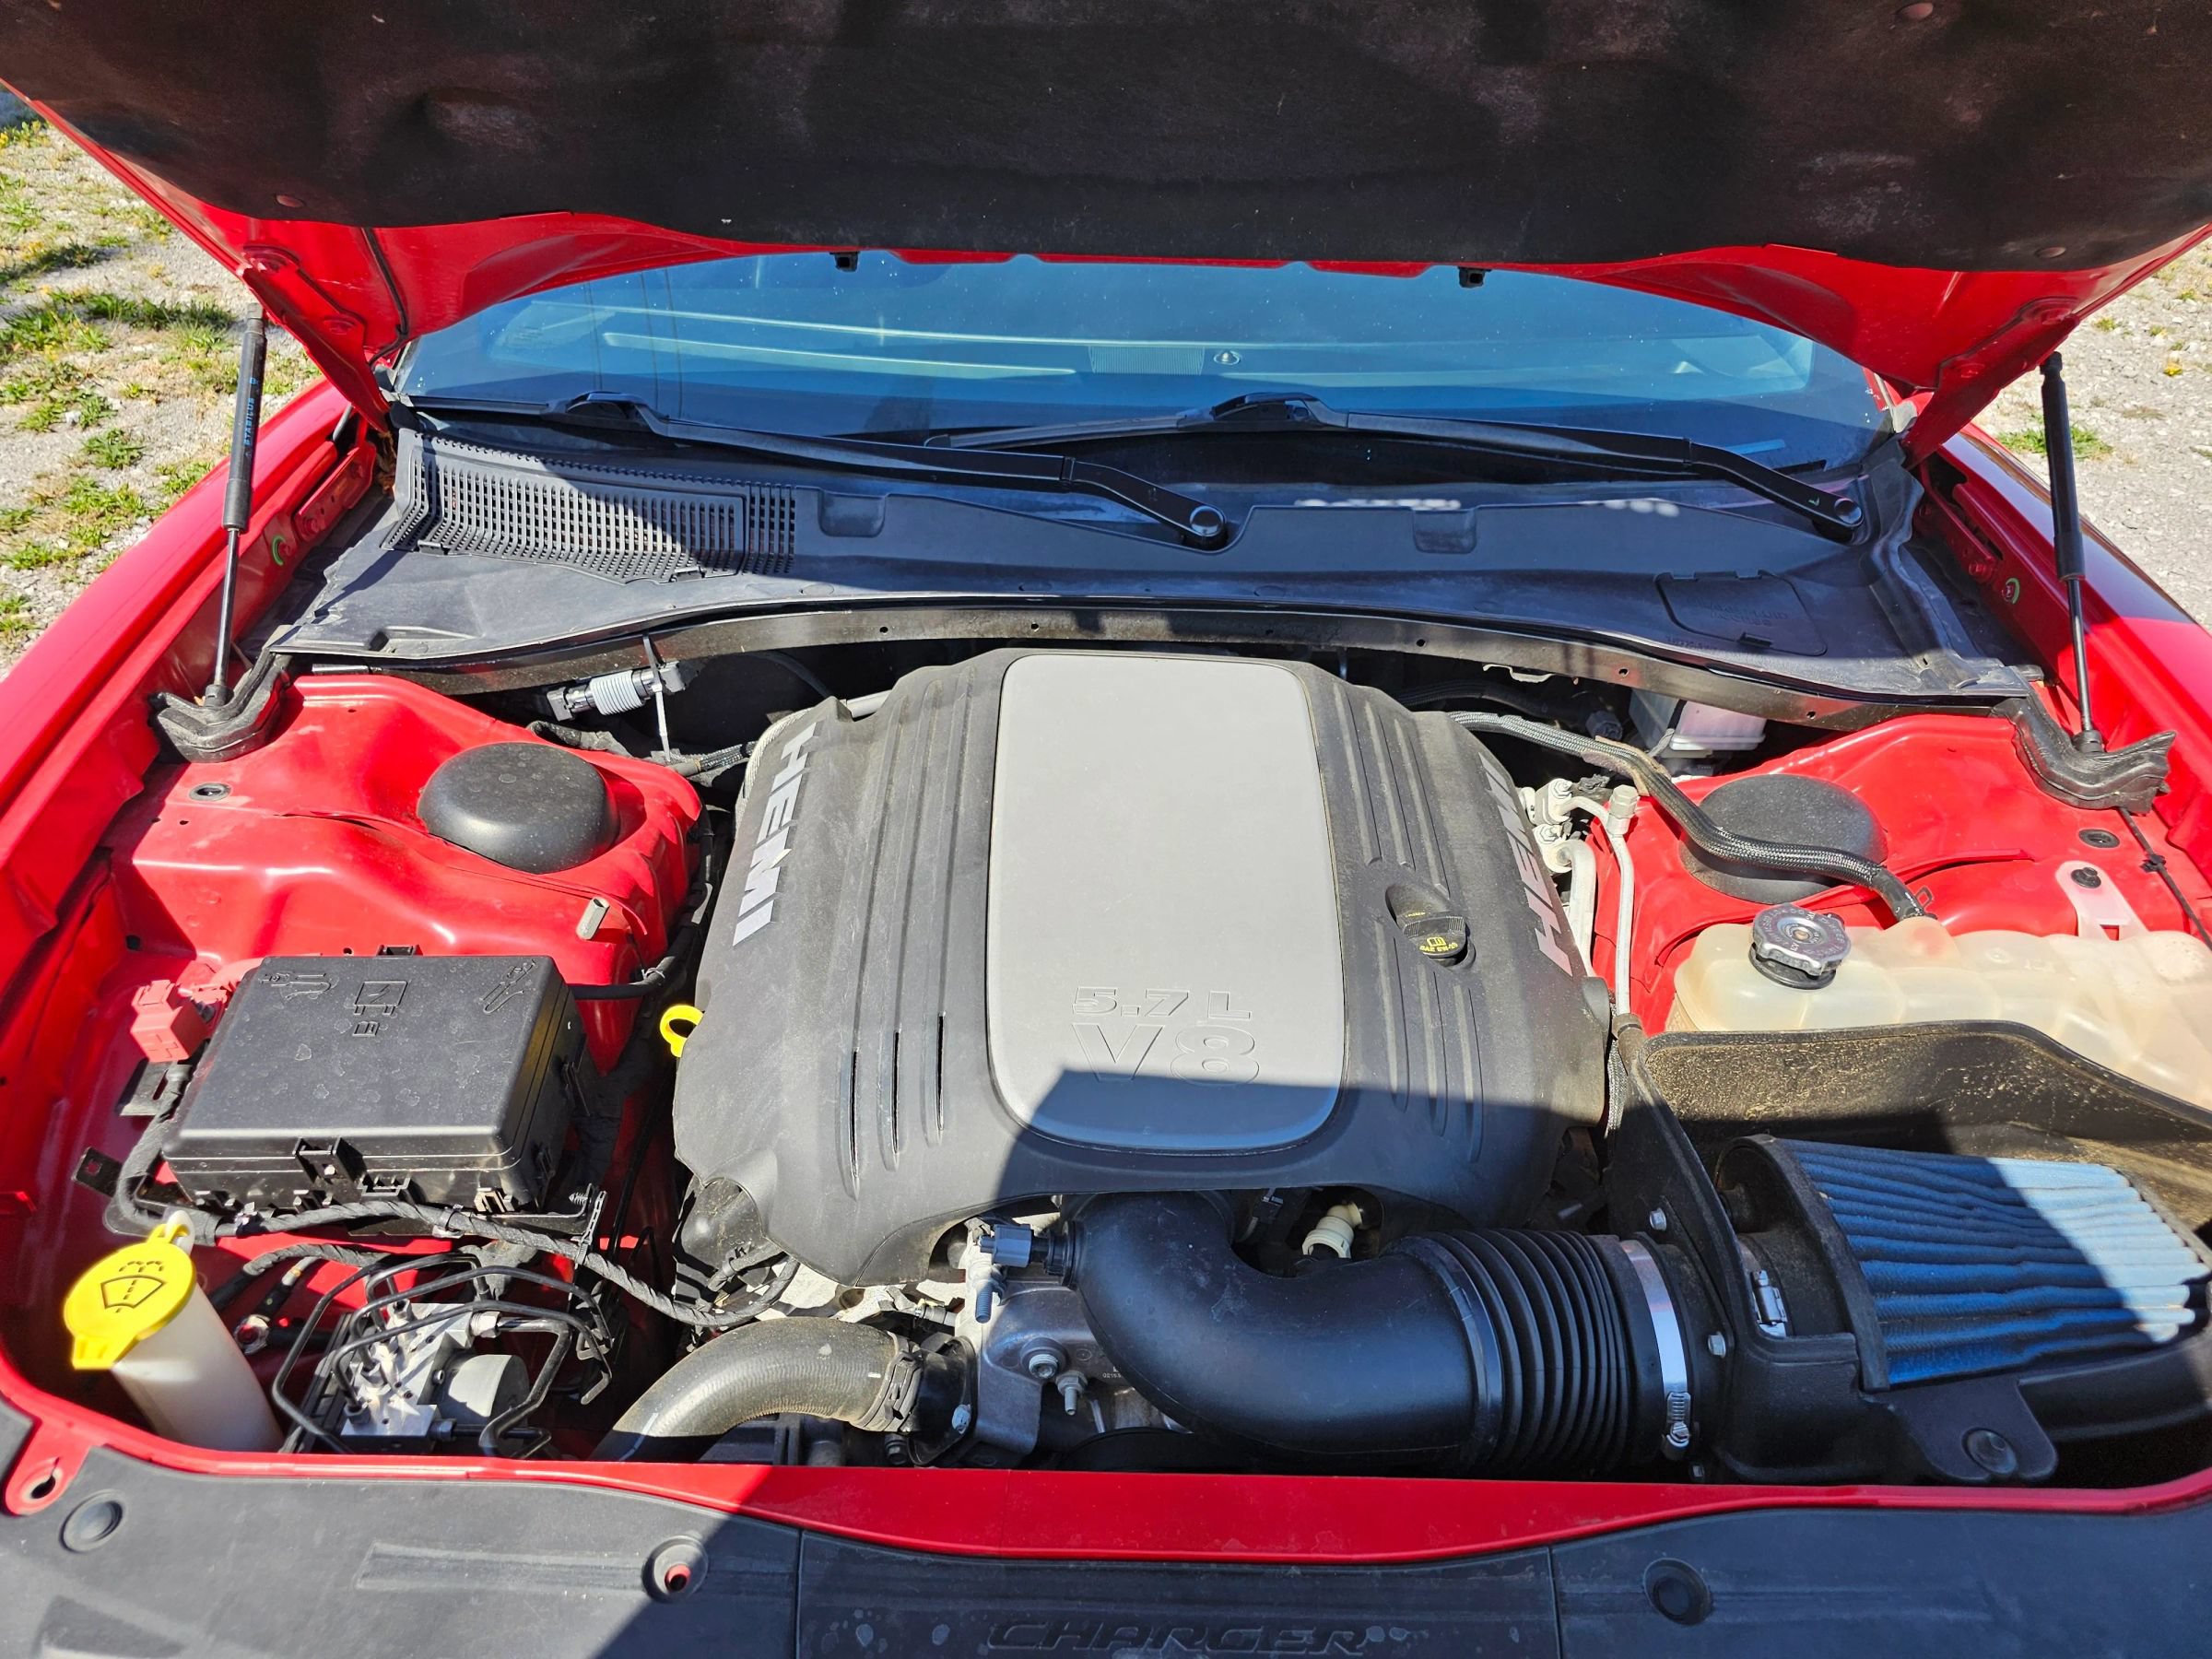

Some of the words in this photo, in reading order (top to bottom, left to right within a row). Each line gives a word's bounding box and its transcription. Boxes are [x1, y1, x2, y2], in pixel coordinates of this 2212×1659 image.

[732, 723, 817, 947] HEMI
[1478, 752, 1573, 977] HEMI
[1072, 1022, 1259, 1087] V8
[988, 1621, 1369, 1656] CHARGER
